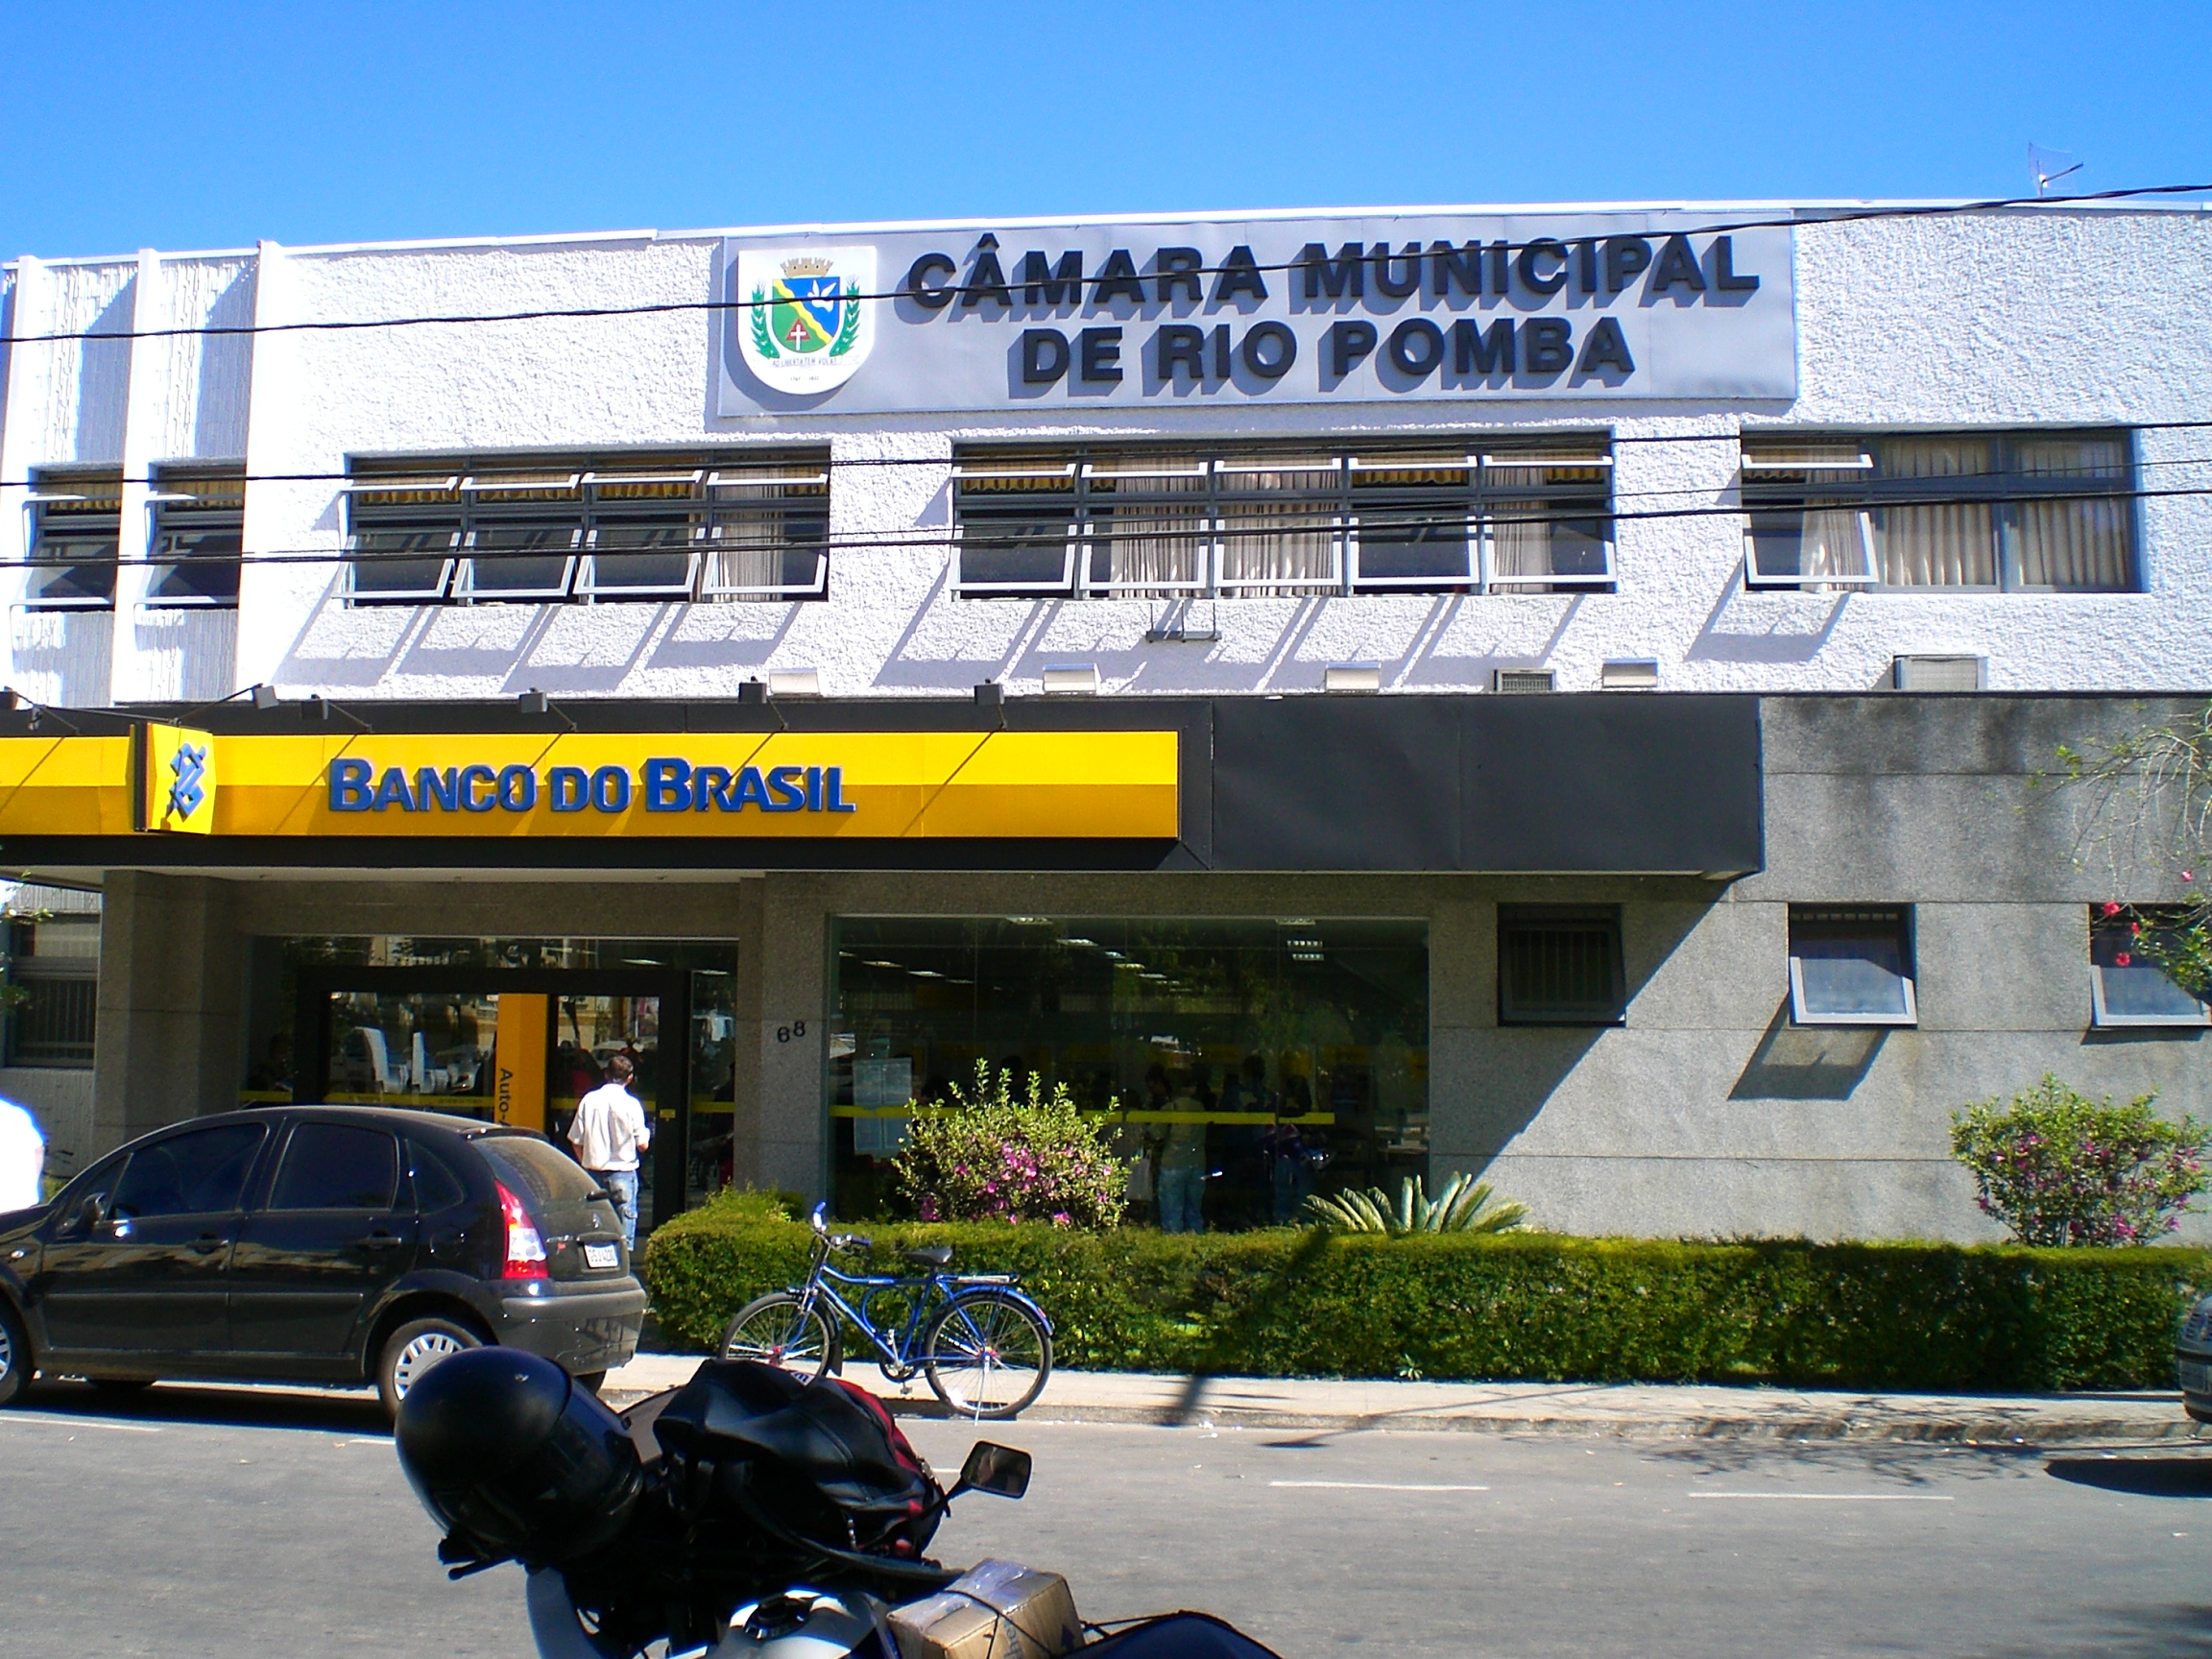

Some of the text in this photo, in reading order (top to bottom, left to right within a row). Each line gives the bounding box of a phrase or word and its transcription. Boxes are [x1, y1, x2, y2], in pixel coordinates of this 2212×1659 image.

[908, 232, 1761, 308] CÂMARA MUNICIPAL
[1023, 316, 1636, 383] DE RIO POMBA
[328, 757, 857, 813] BANCO DO BRASIL
[778, 1021, 805, 1044] 68
